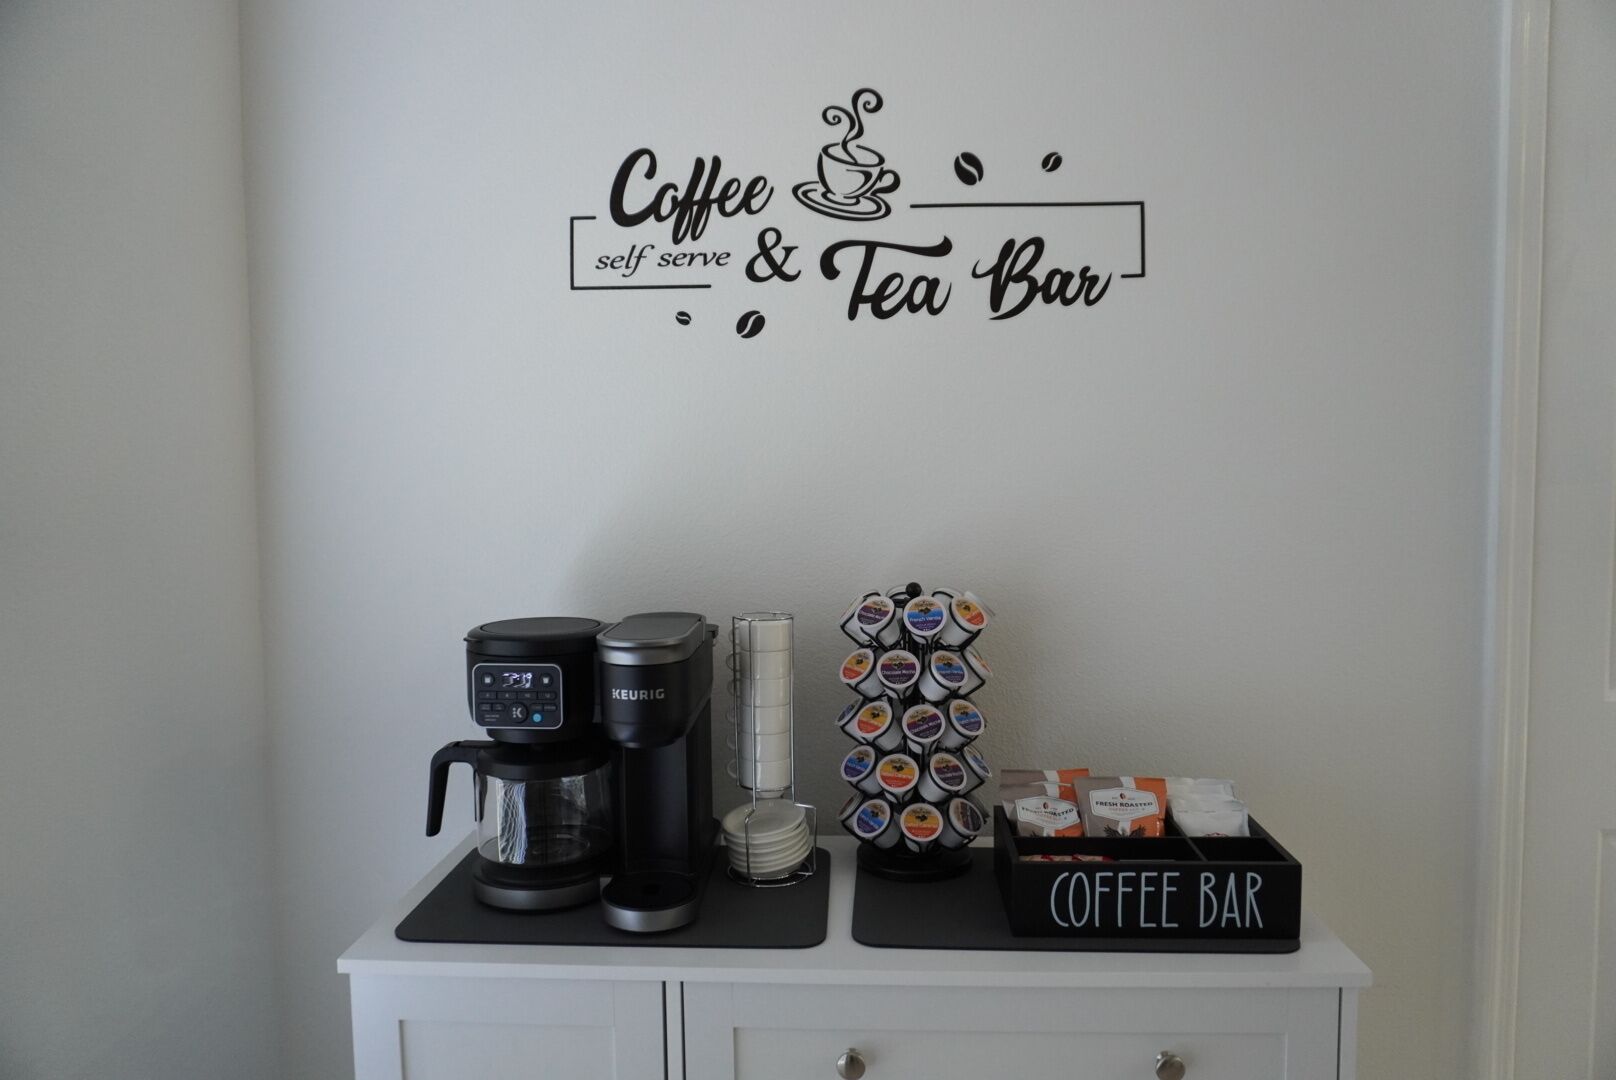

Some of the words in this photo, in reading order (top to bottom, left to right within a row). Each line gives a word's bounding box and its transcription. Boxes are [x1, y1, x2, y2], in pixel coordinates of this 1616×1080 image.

[609, 148, 775, 246] Coffee
[595, 243, 654, 278] self
[656, 250, 731, 268] serve
[745, 227, 802, 283] &
[819, 235, 953, 322] Tea
[971, 236, 1113, 321] Bar
[612, 688, 665, 701] KEURIG
[1050, 871, 1180, 928] COFFEE
[1199, 871, 1263, 928] BAR
